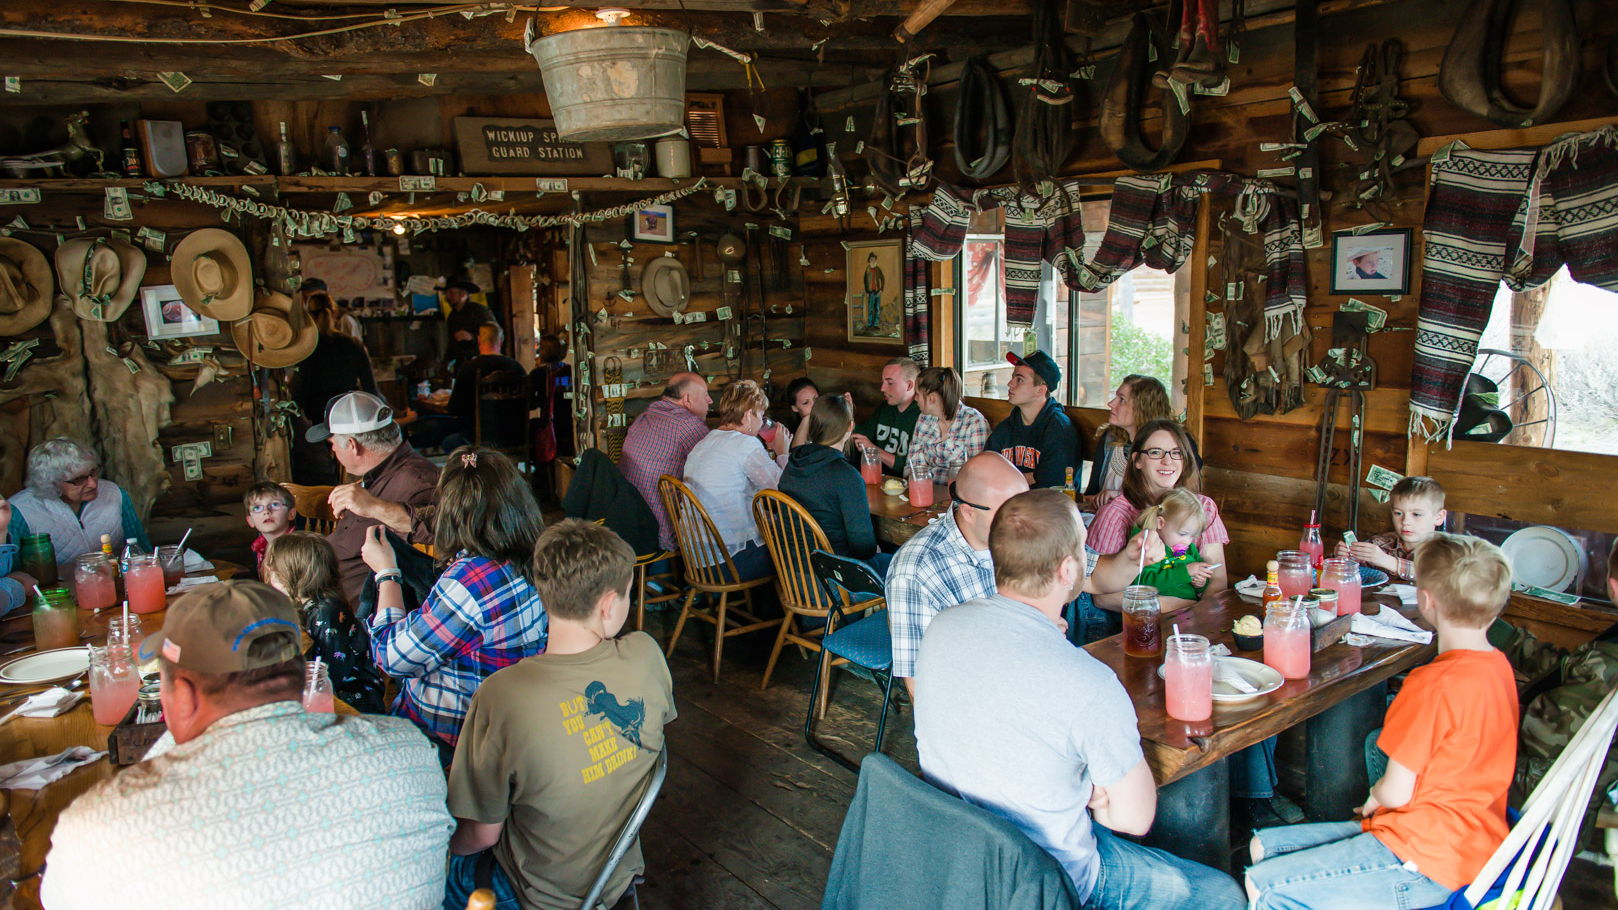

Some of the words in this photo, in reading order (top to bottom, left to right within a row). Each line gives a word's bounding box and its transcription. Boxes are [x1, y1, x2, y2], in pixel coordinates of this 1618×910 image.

[486, 130, 534, 142] WICKIUP
[492, 146, 530, 158] GUARD
[539, 147, 583, 159] STATION
[560, 695, 586, 718] BUT
[562, 714, 585, 736] YOU
[582, 720, 615, 746] CAN'T
[588, 736, 618, 763] MAKE
[581, 762, 605, 784] HIM
[604, 744, 637, 774] DRINK!
